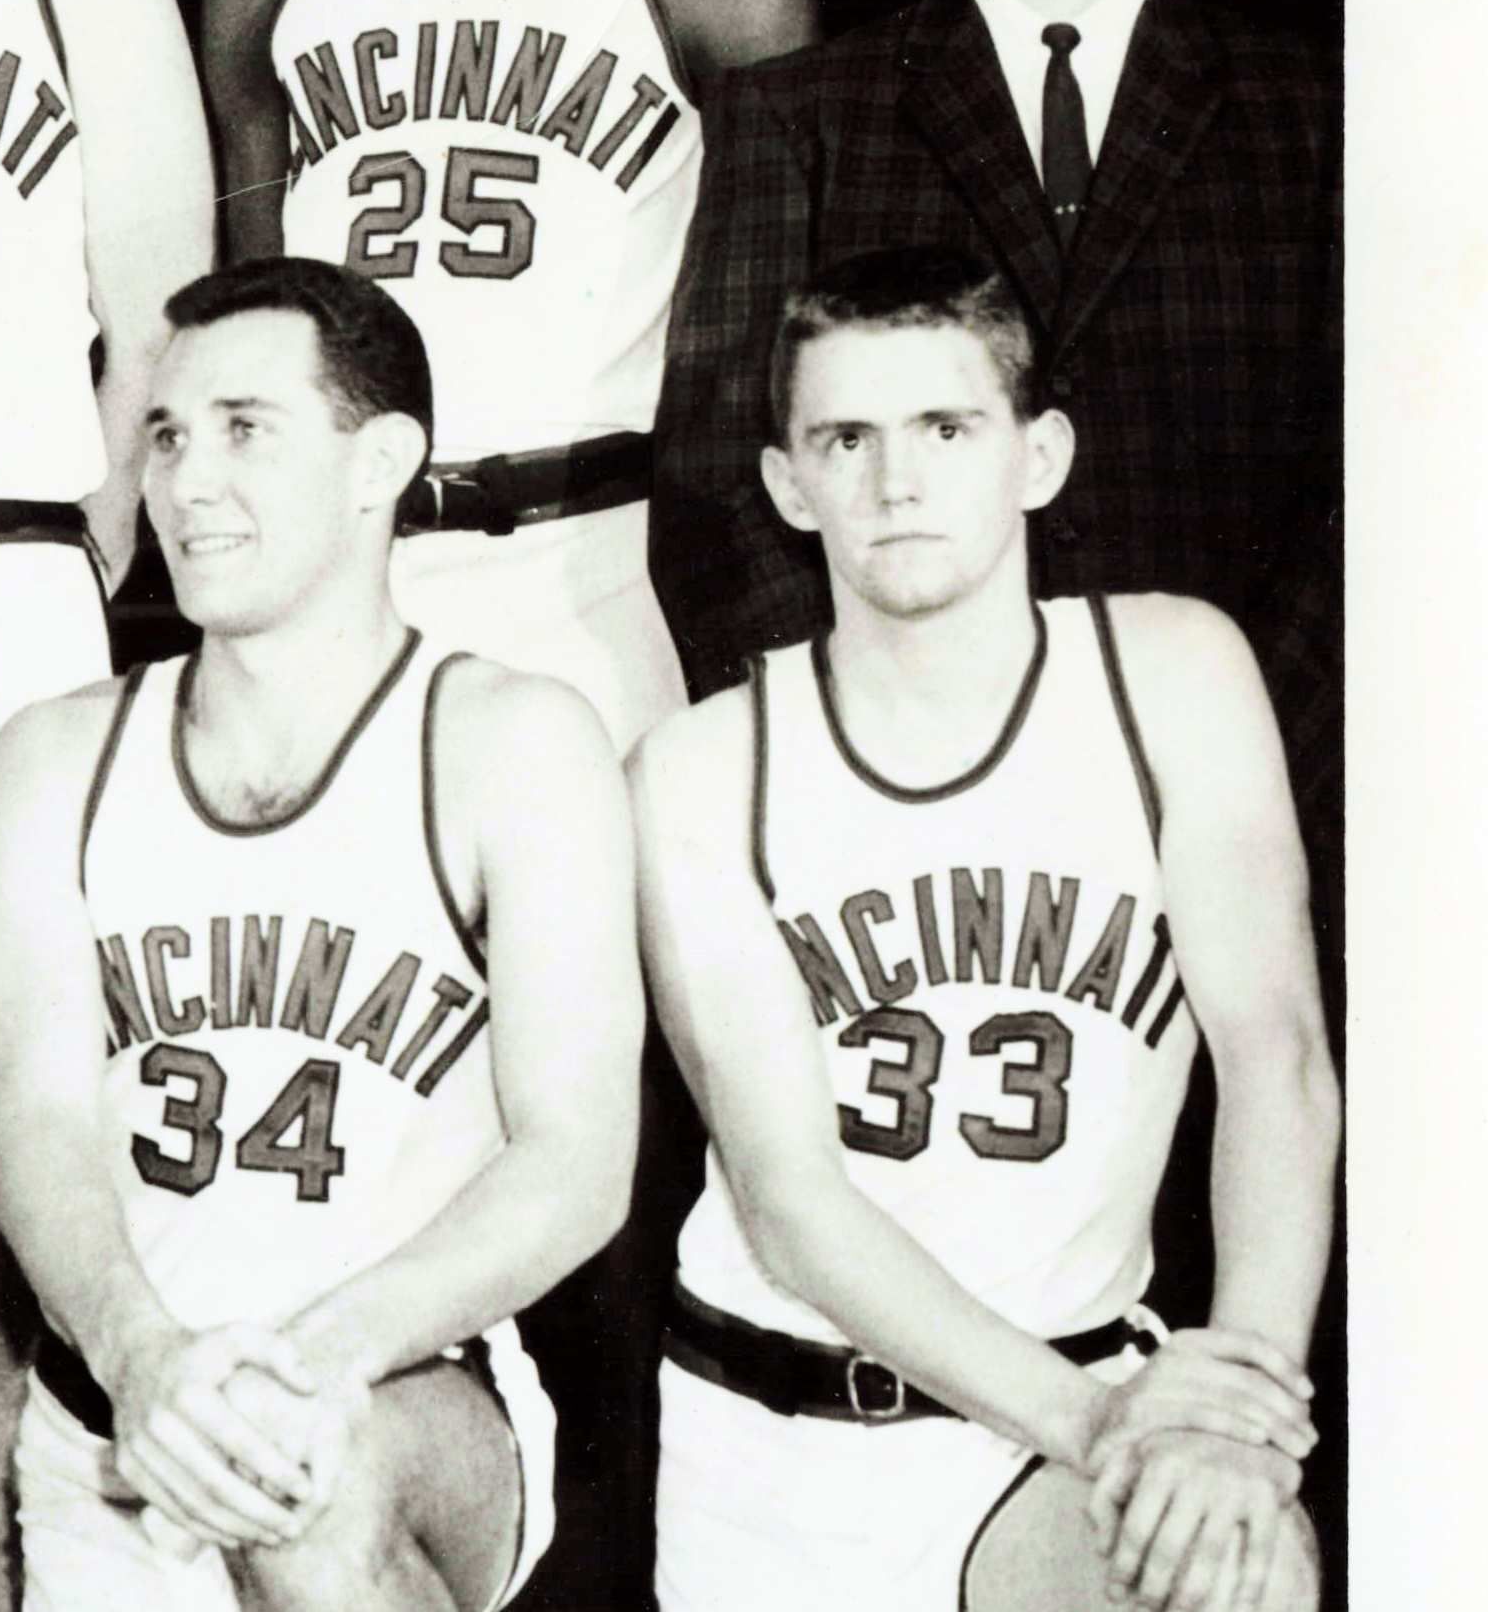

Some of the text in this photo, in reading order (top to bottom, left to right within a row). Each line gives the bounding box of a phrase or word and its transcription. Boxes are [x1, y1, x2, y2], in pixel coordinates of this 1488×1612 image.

[282, 19, 681, 193] INCINNATI
[345, 146, 539, 280] 25
[97, 915, 490, 1098] NCINNATI
[776, 867, 1186, 1049] NCINNATI
[131, 1041, 345, 1203] 34
[837, 1005, 1073, 1162] 33
